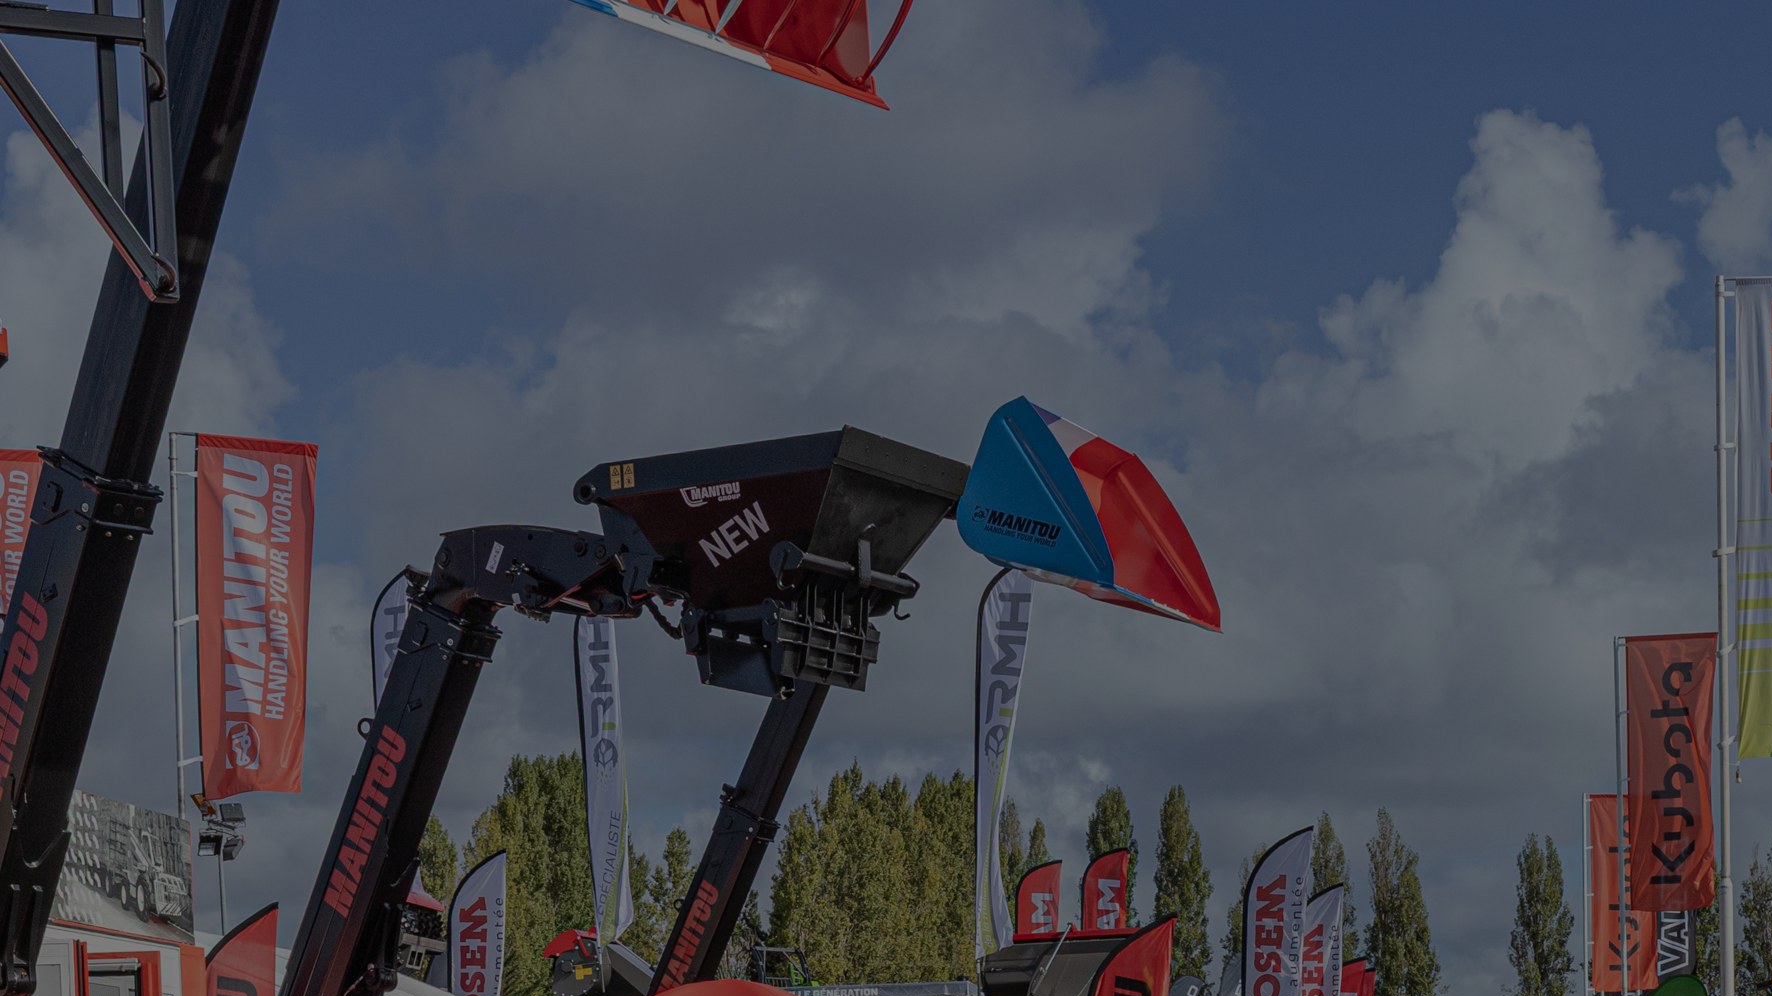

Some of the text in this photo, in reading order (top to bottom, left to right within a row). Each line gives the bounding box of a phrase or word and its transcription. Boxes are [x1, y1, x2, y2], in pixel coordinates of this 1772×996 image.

[4, 470, 29, 606] OUR WORLD
[690, 482, 740, 501] MANITOU
[698, 500, 770, 568] NEW
[717, 493, 742, 502] GROUP
[984, 524, 1016, 538] HANDLING
[987, 509, 1062, 540] MANITOU
[222, 453, 270, 717] MANITOU
[265, 463, 293, 720] HANDLING YOUR WORLD
[323, 724, 407, 918] MANITOU
[1651, 662, 1695, 884] Kubota
[1289, 876, 1304, 987] augmentée
